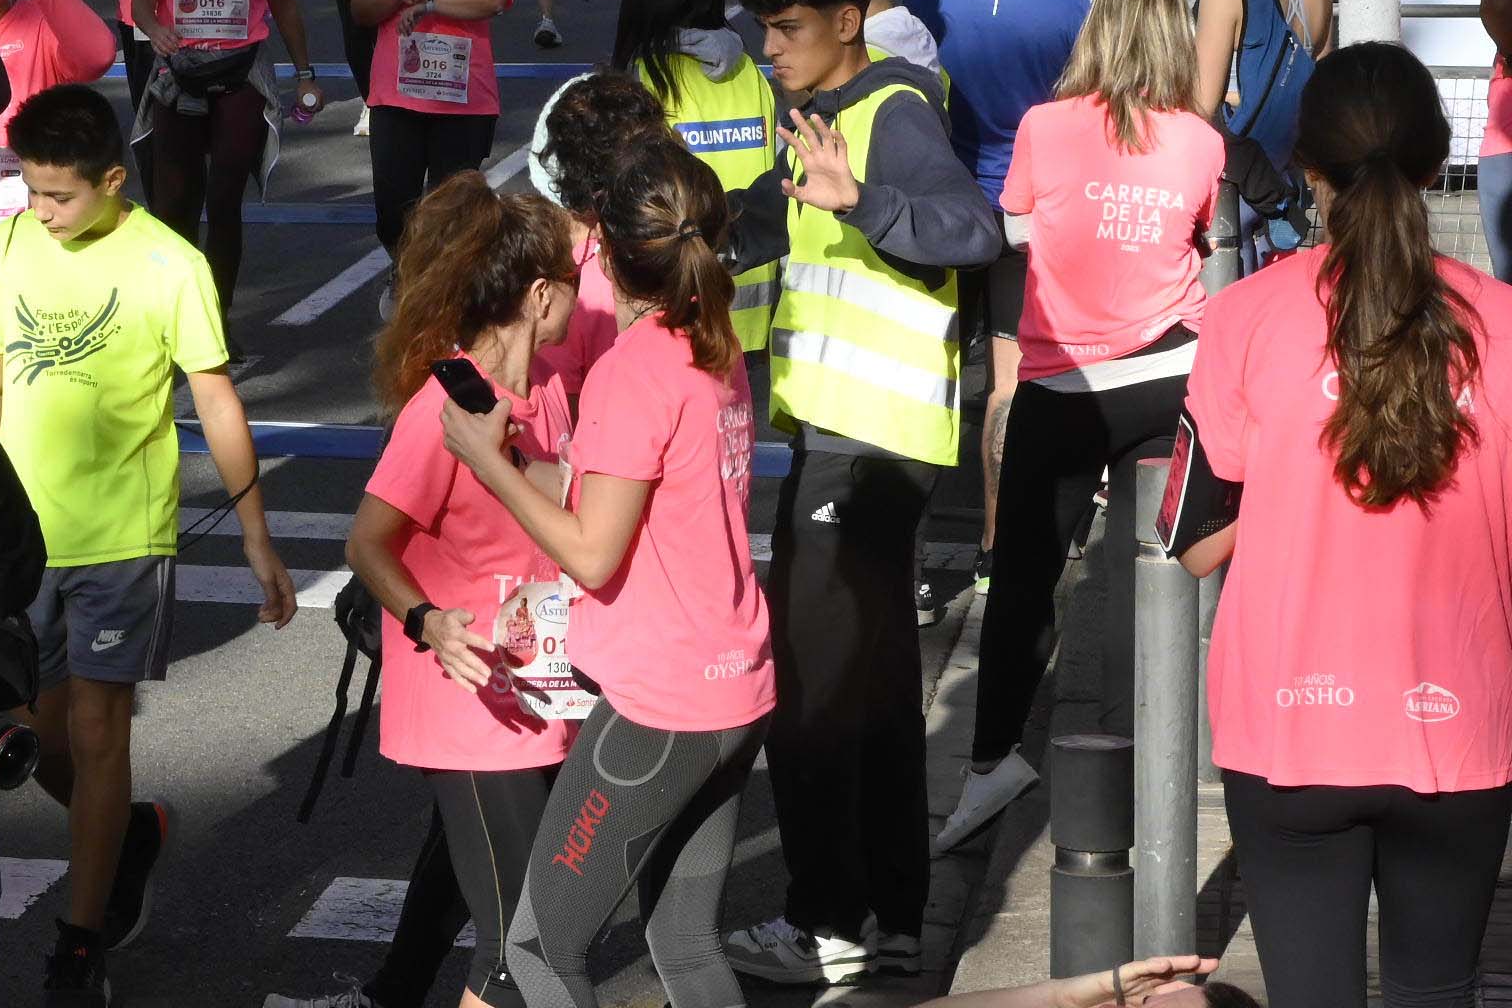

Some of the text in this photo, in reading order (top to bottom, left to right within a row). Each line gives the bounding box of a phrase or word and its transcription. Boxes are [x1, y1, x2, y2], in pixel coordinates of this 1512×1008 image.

[422, 59, 448, 70] 016
[1085, 181, 1186, 211] CARRERA
[1102, 201, 1163, 226] DE LA
[1096, 222, 1165, 246] MUJER
[36, 308, 79, 321] Festa de
[49, 312, 90, 334] l'Esport
[1057, 342, 1110, 358] OYSHO
[811, 513, 841, 524] adidas
[97, 629, 125, 642] NIKE
[547, 661, 572, 674] 1300
[1304, 672, 1336, 685] AÑOS
[1275, 686, 1355, 709] OYSHO
